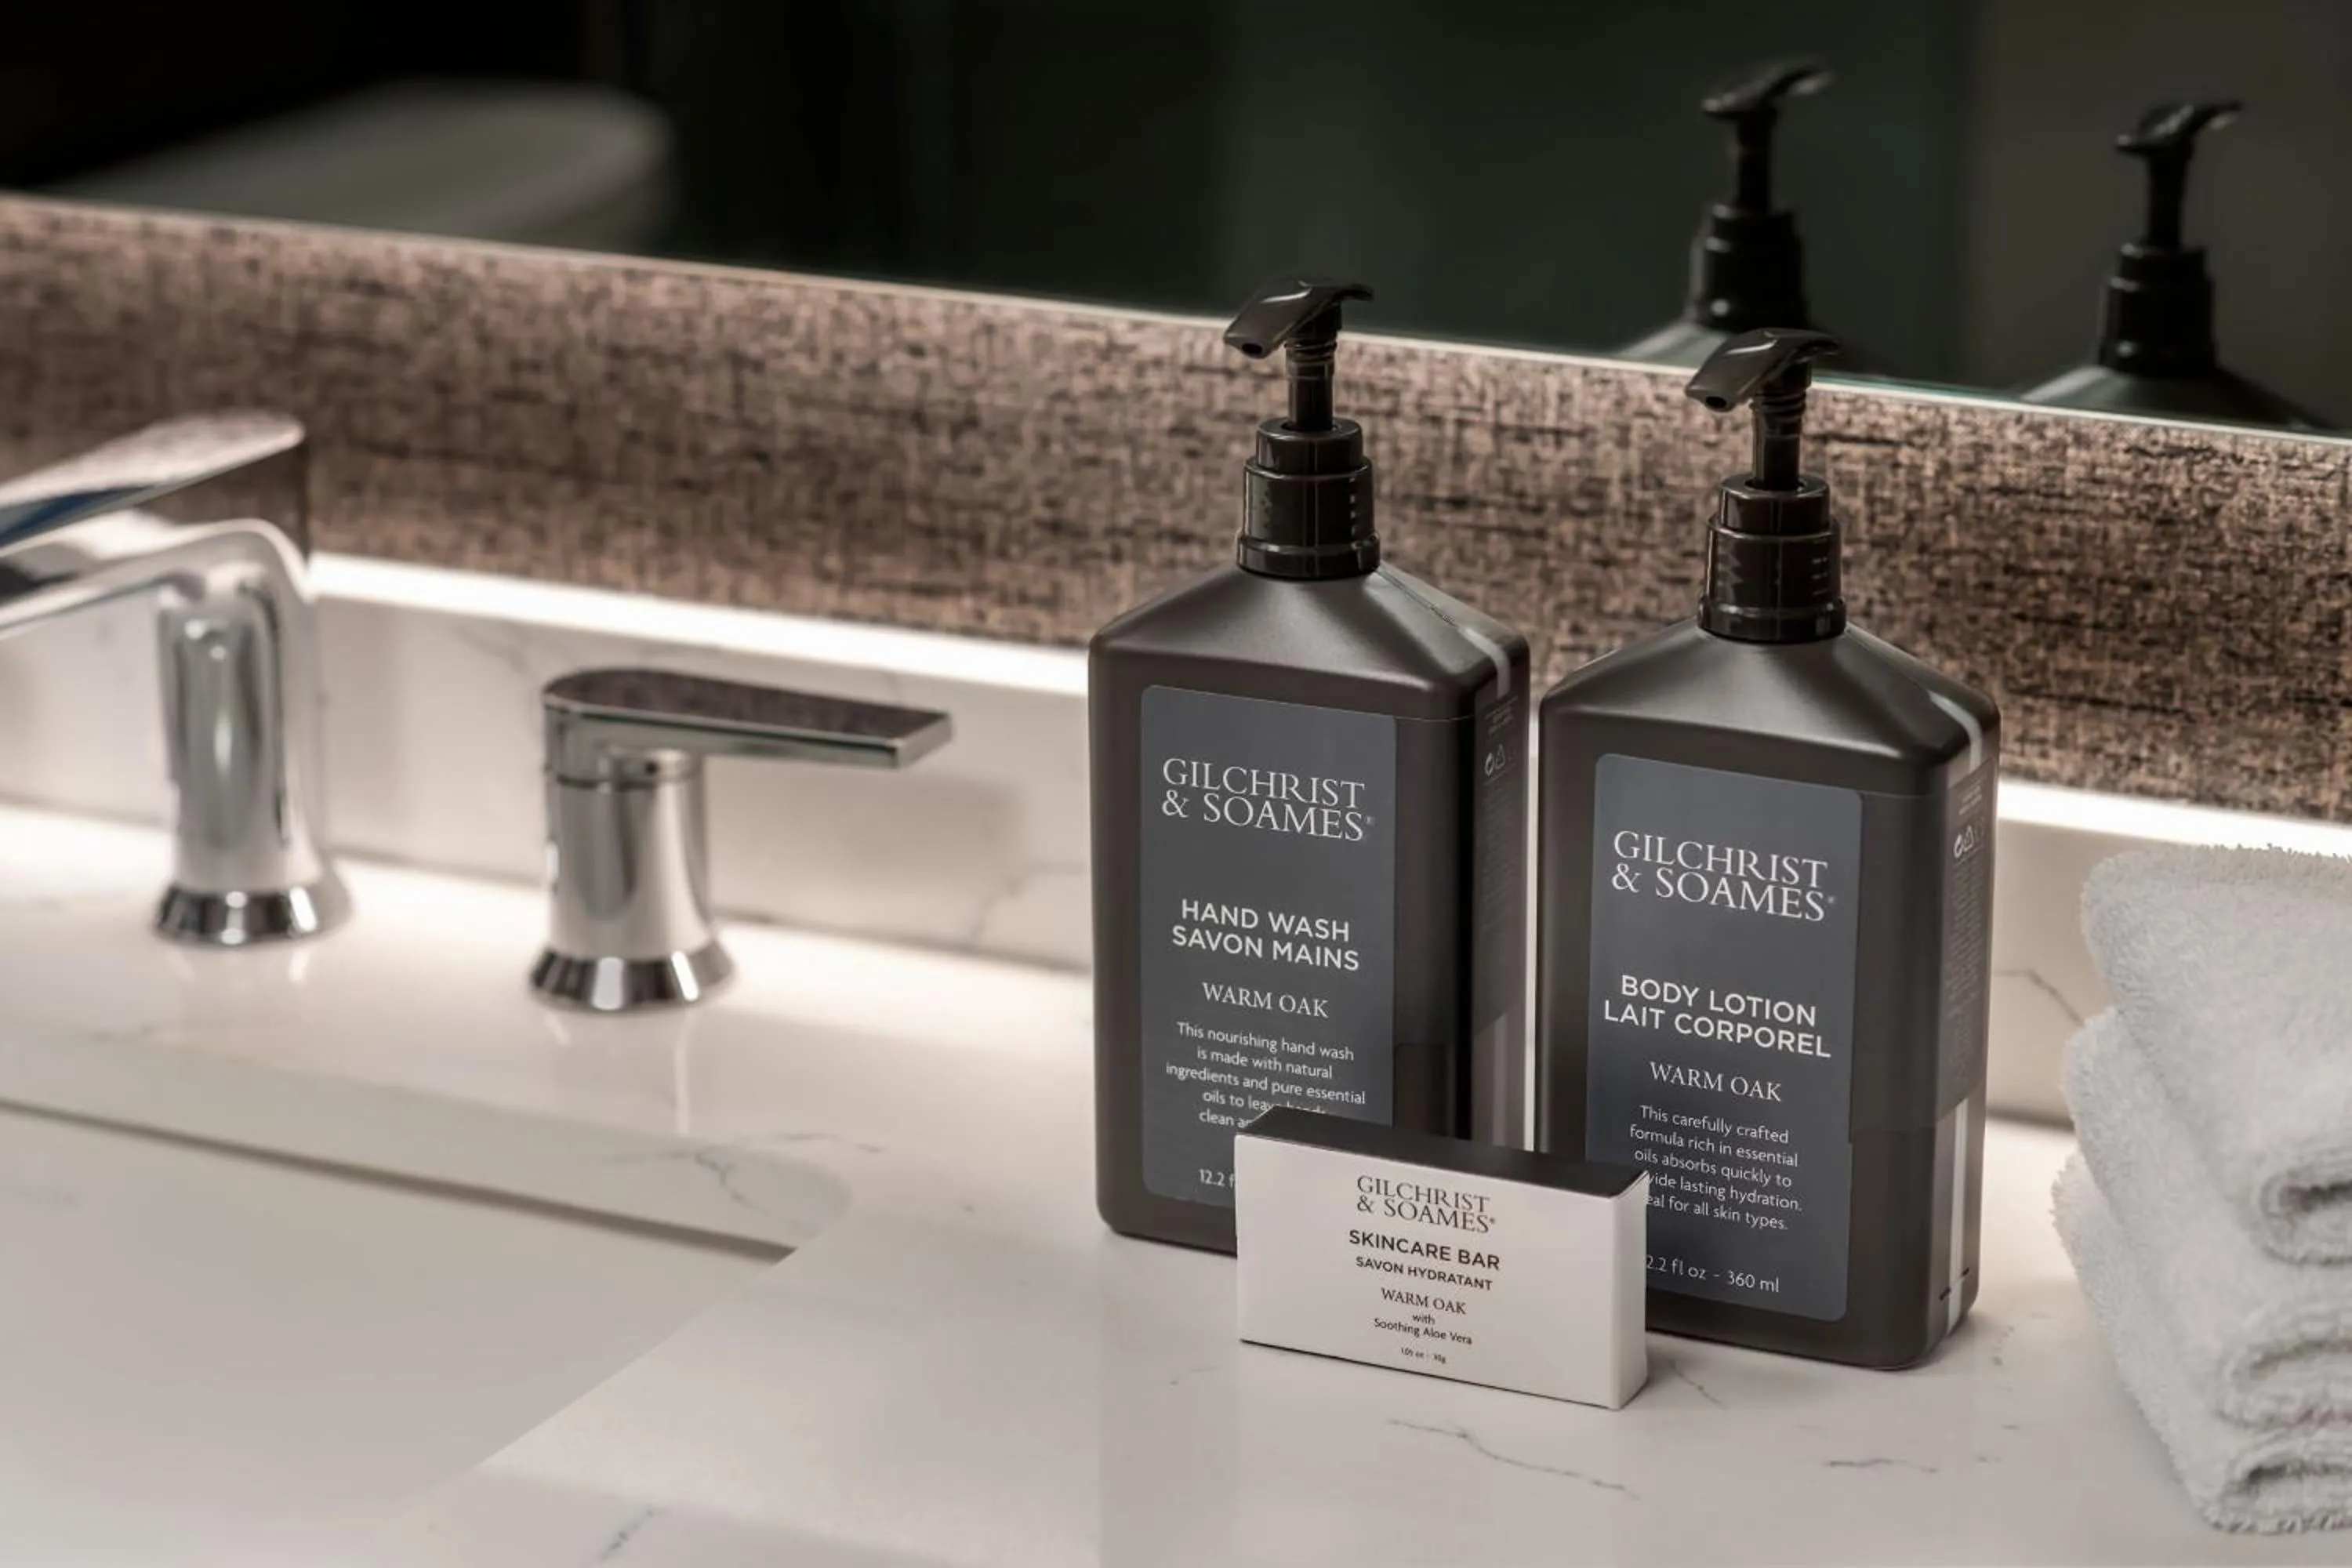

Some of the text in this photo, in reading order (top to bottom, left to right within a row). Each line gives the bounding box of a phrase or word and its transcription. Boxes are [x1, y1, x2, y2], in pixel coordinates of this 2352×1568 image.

[1163, 757, 1366, 809] GILCHRIST
[1162, 789, 1190, 818] &
[1611, 863, 1642, 893] &
[1613, 830, 1828, 888] GILCHRIST
[1181, 898, 1350, 942] HAND WASH
[1172, 925, 1359, 971] SAVON MAINS
[1202, 982, 1330, 1018] WARM OAK
[1621, 975, 1816, 1027] BODY LOTION
[1177, 1022, 1355, 1061] This nourishing hand wash
[1604, 1000, 1832, 1058] LAIT CORPOREL
[1197, 1047, 1333, 1080] is made with natural
[1650, 1061, 1782, 1102] WARM OAK
[1166, 1062, 1366, 1105] ingredients and pure essential
[1202, 1090, 1226, 1103] oils
[1229, 1094, 1245, 1108] to
[1199, 1108, 1235, 1127] clean
[1640, 1105, 1789, 1144] This carefully crafted
[1630, 1124, 1798, 1167] formula rich in essential
[1200, 1168, 1225, 1187] 12.2
[1634, 1149, 1792, 1189] oils absorbs quickly to
[1357, 1175, 1490, 1214] GILCHRIST
[1357, 1196, 1374, 1214] &
[1680, 1176, 1726, 1202] lasting
[1730, 1185, 1802, 1211] hydration.
[1668, 1196, 1690, 1212] for
[1693, 1200, 1710, 1216] all
[1713, 1206, 1741, 1222] skin
[1745, 1213, 1789, 1231] types.
[1348, 1229, 1501, 1271] SKINCARE BAR
[1356, 1256, 1494, 1291] SAVON HYDRATANT
[1646, 1255, 1667, 1273] 2.2
[1671, 1259, 1684, 1276] fl
[1688, 1266, 1707, 1281] oz
[1727, 1271, 1755, 1289] 360
[1759, 1277, 1780, 1293] ml
[1381, 1288, 1466, 1315] WARM OAK
[1412, 1314, 1436, 1325] with
[1374, 1318, 1472, 1345] Soothing Aloe Vera
